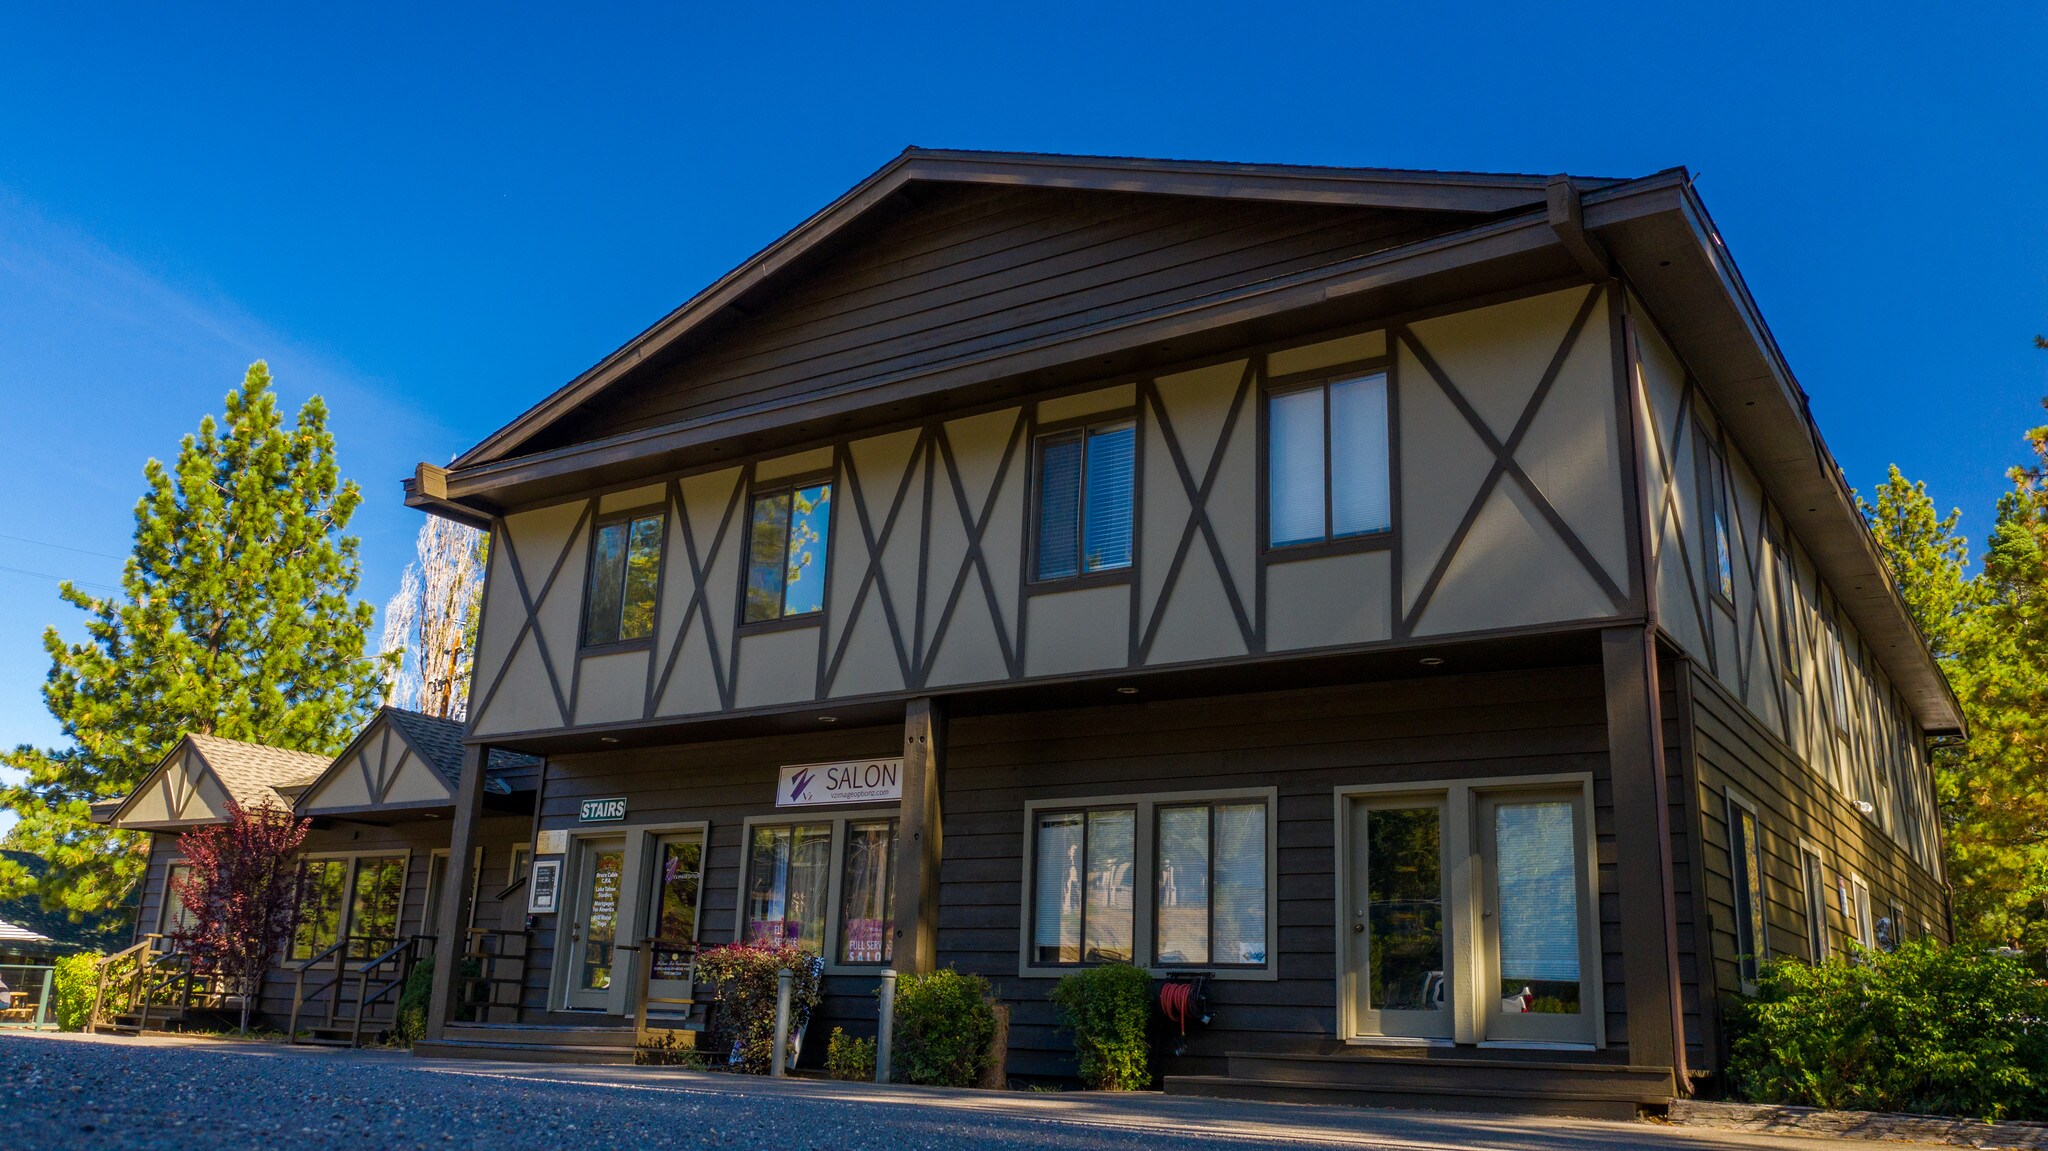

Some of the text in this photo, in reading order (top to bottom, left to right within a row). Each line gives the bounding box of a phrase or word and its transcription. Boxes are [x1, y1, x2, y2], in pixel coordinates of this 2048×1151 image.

[826, 763, 897, 790] SALON
[582, 801, 624, 818] STAIRS
[850, 940, 865, 950] FULL
